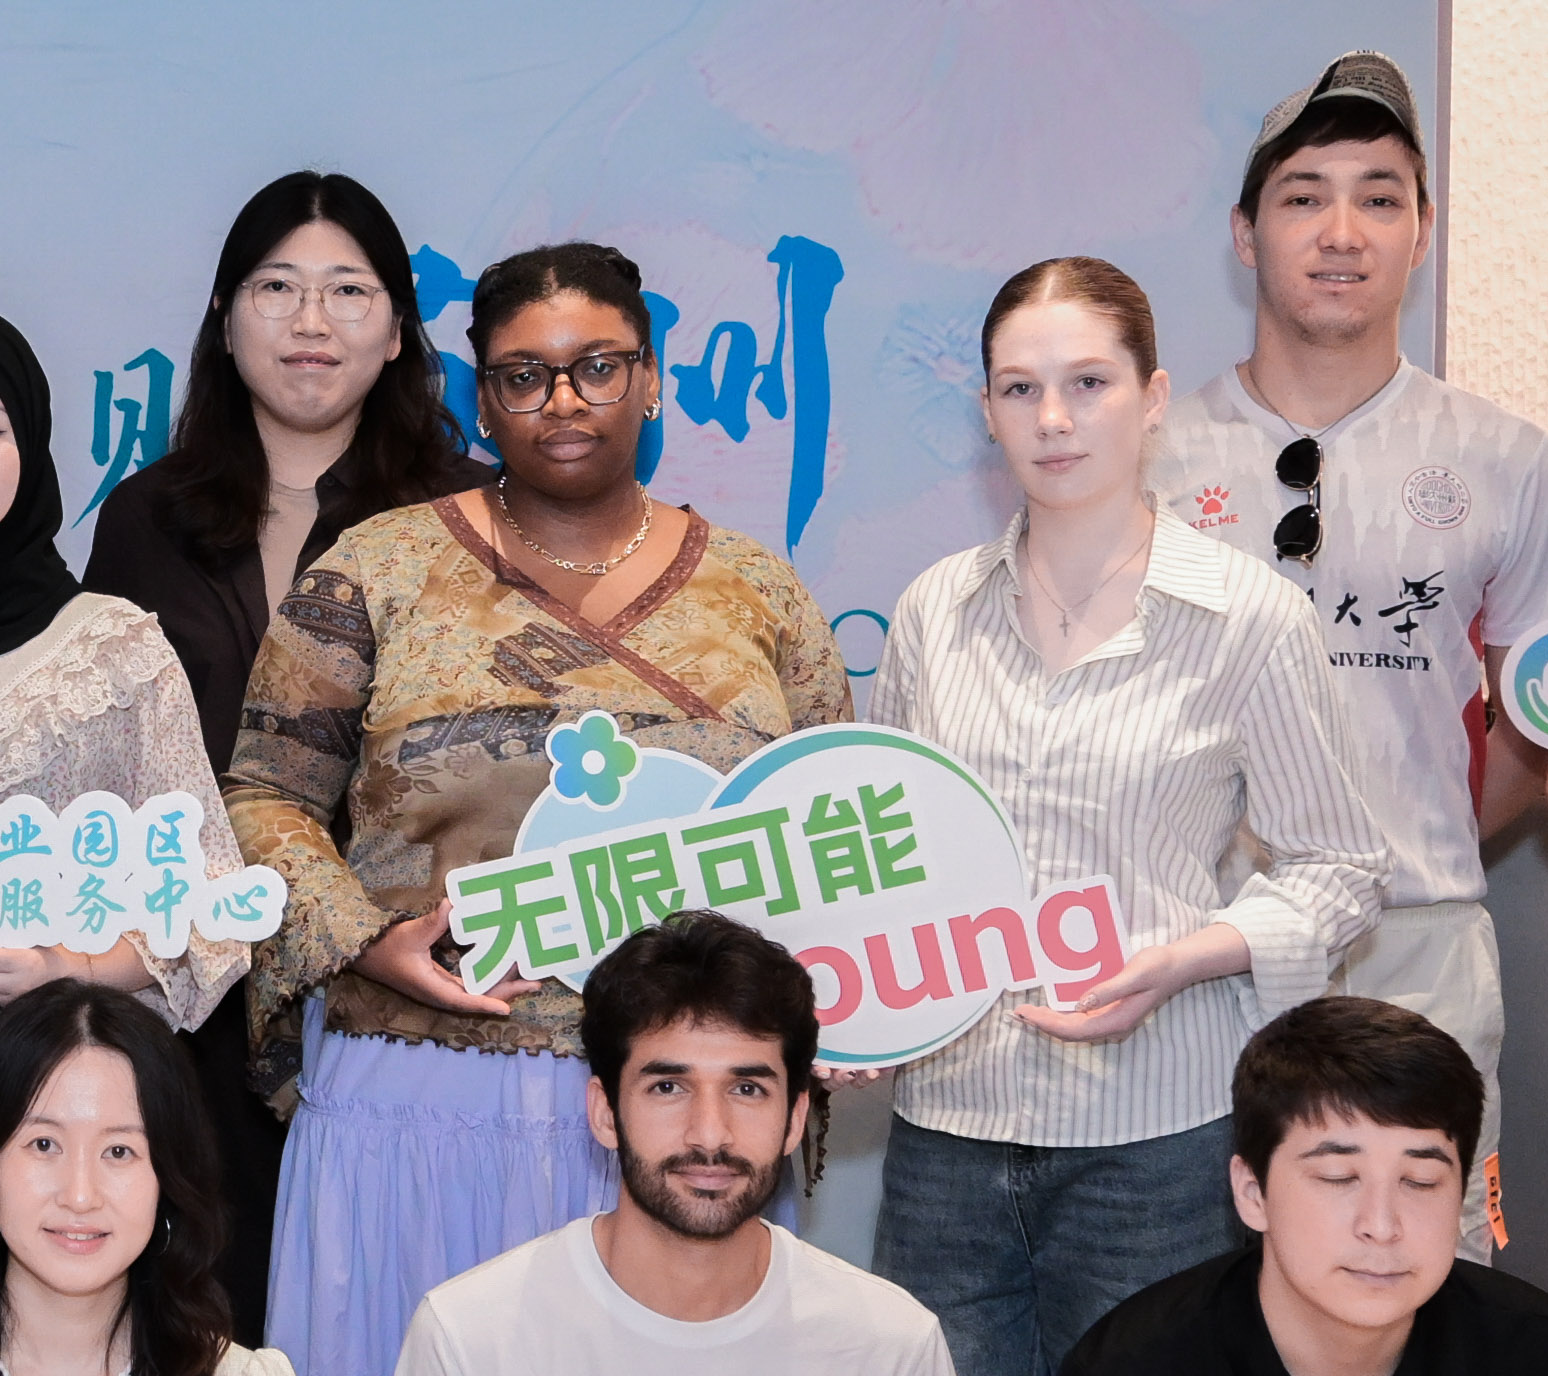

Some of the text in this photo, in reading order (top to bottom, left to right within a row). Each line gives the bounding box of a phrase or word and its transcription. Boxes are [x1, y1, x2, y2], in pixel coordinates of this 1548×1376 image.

[1328, 651, 1434, 673] NIVERSITY
[457, 783, 926, 983] 无限可能
[794, 884, 1127, 1028] oung
